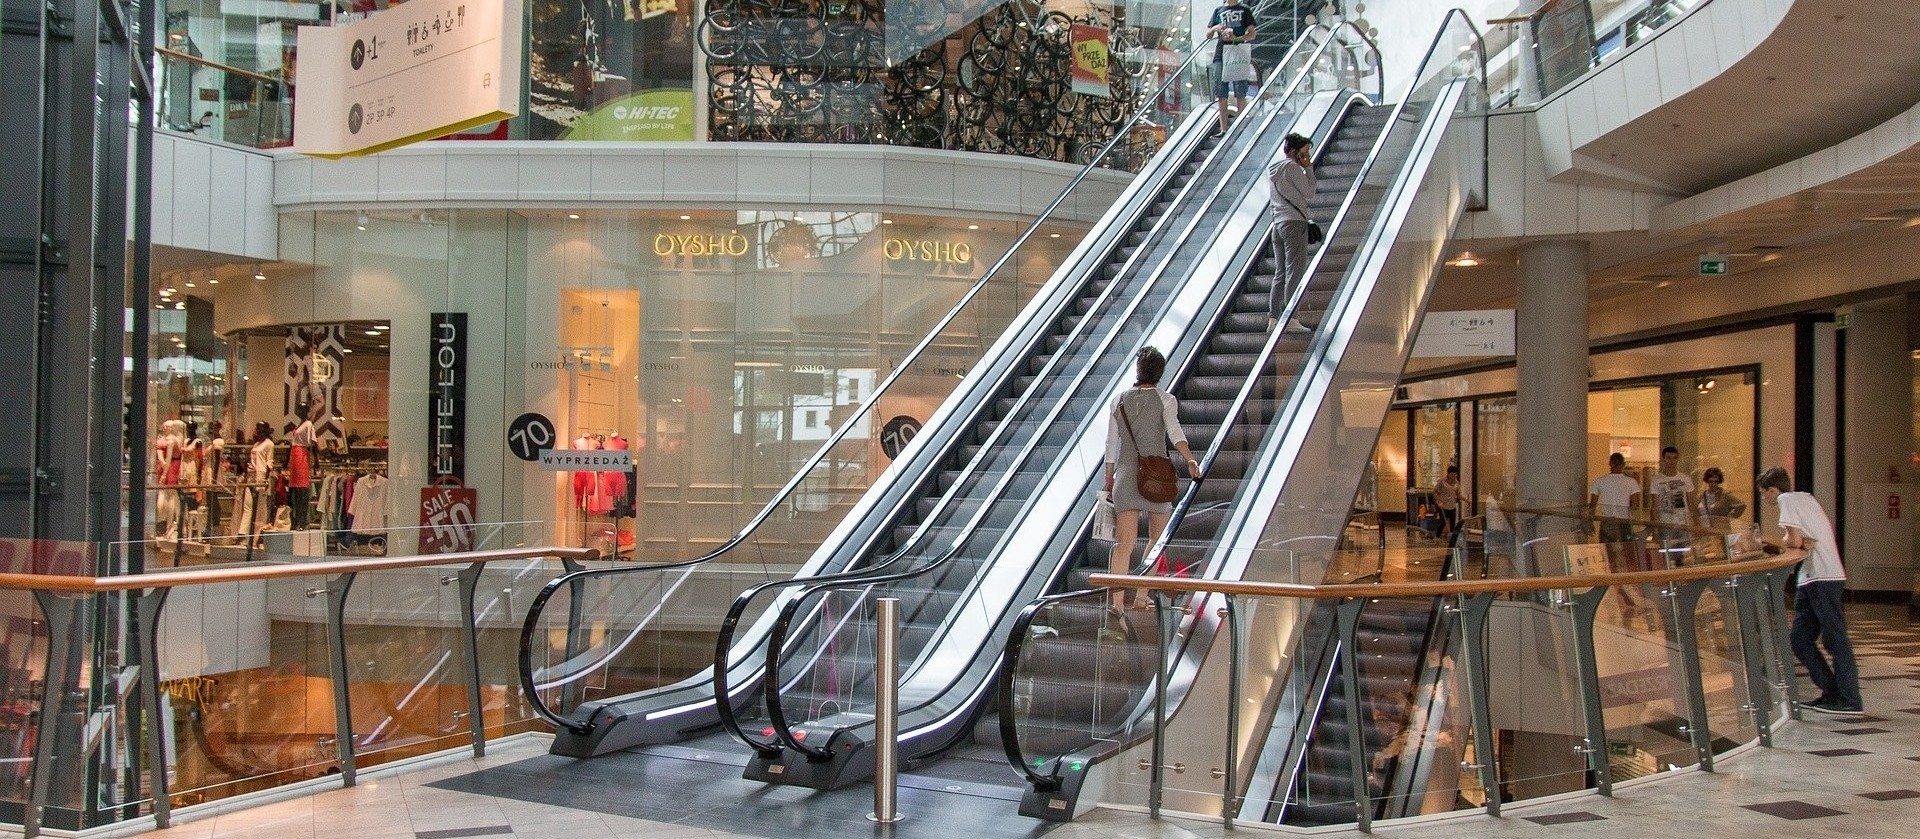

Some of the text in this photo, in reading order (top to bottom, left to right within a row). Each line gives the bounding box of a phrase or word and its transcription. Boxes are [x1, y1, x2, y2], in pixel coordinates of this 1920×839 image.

[1219, 9, 1244, 24] FAST
[366, 35, 379, 60] +1
[412, 43, 434, 58] TOALETY
[1077, 43, 1088, 53] WY
[1082, 50, 1101, 61] PRZE
[628, 106, 680, 120] HI-TEC
[660, 122, 675, 130] LIFE
[653, 233, 748, 256] OYSHO
[884, 237, 971, 264] OYSHO
[437, 323, 456, 386] LOU
[530, 361, 566, 370] OYSHO
[644, 362, 680, 371] OYSHO
[789, 364, 825, 374] OYSHO
[933, 367, 966, 377] OYSHO
[543, 455, 630, 465] WYPRZEDAŻ
[423, 489, 455, 516] SALE
